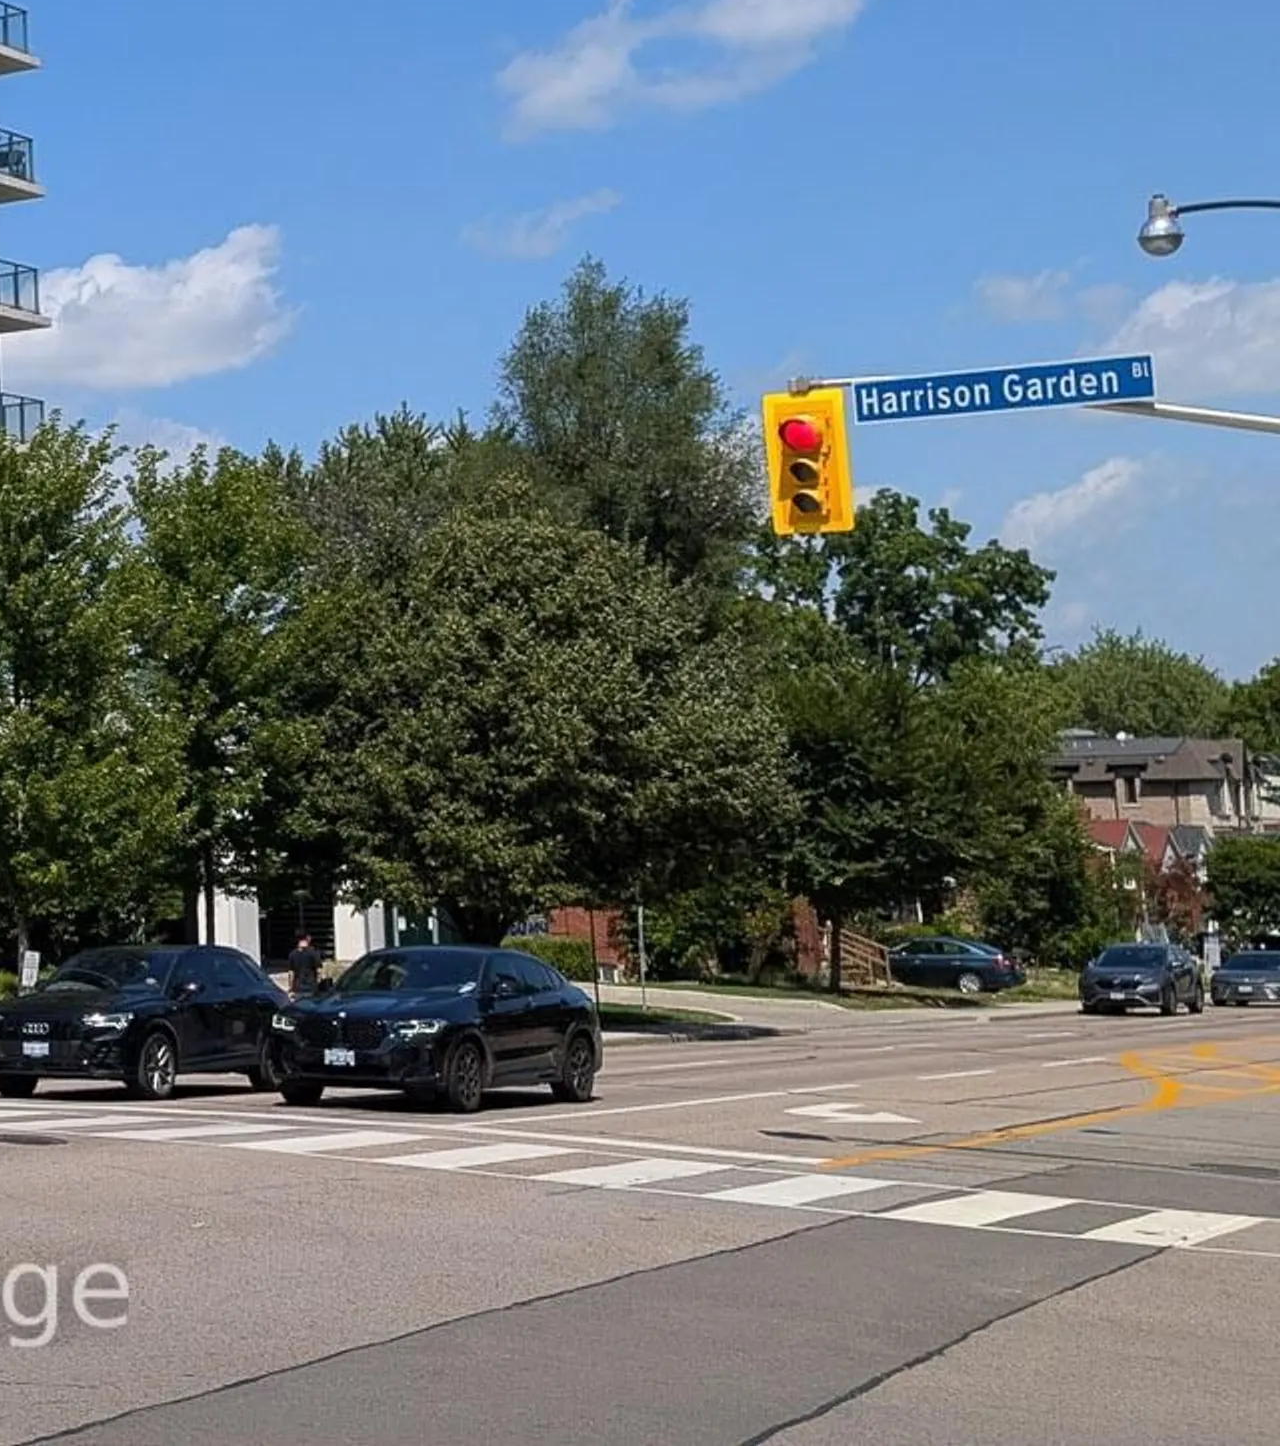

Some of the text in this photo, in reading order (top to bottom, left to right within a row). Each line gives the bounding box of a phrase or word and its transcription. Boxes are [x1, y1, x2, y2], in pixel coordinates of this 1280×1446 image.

[860, 361, 1150, 416] Harrison Garden Bl
